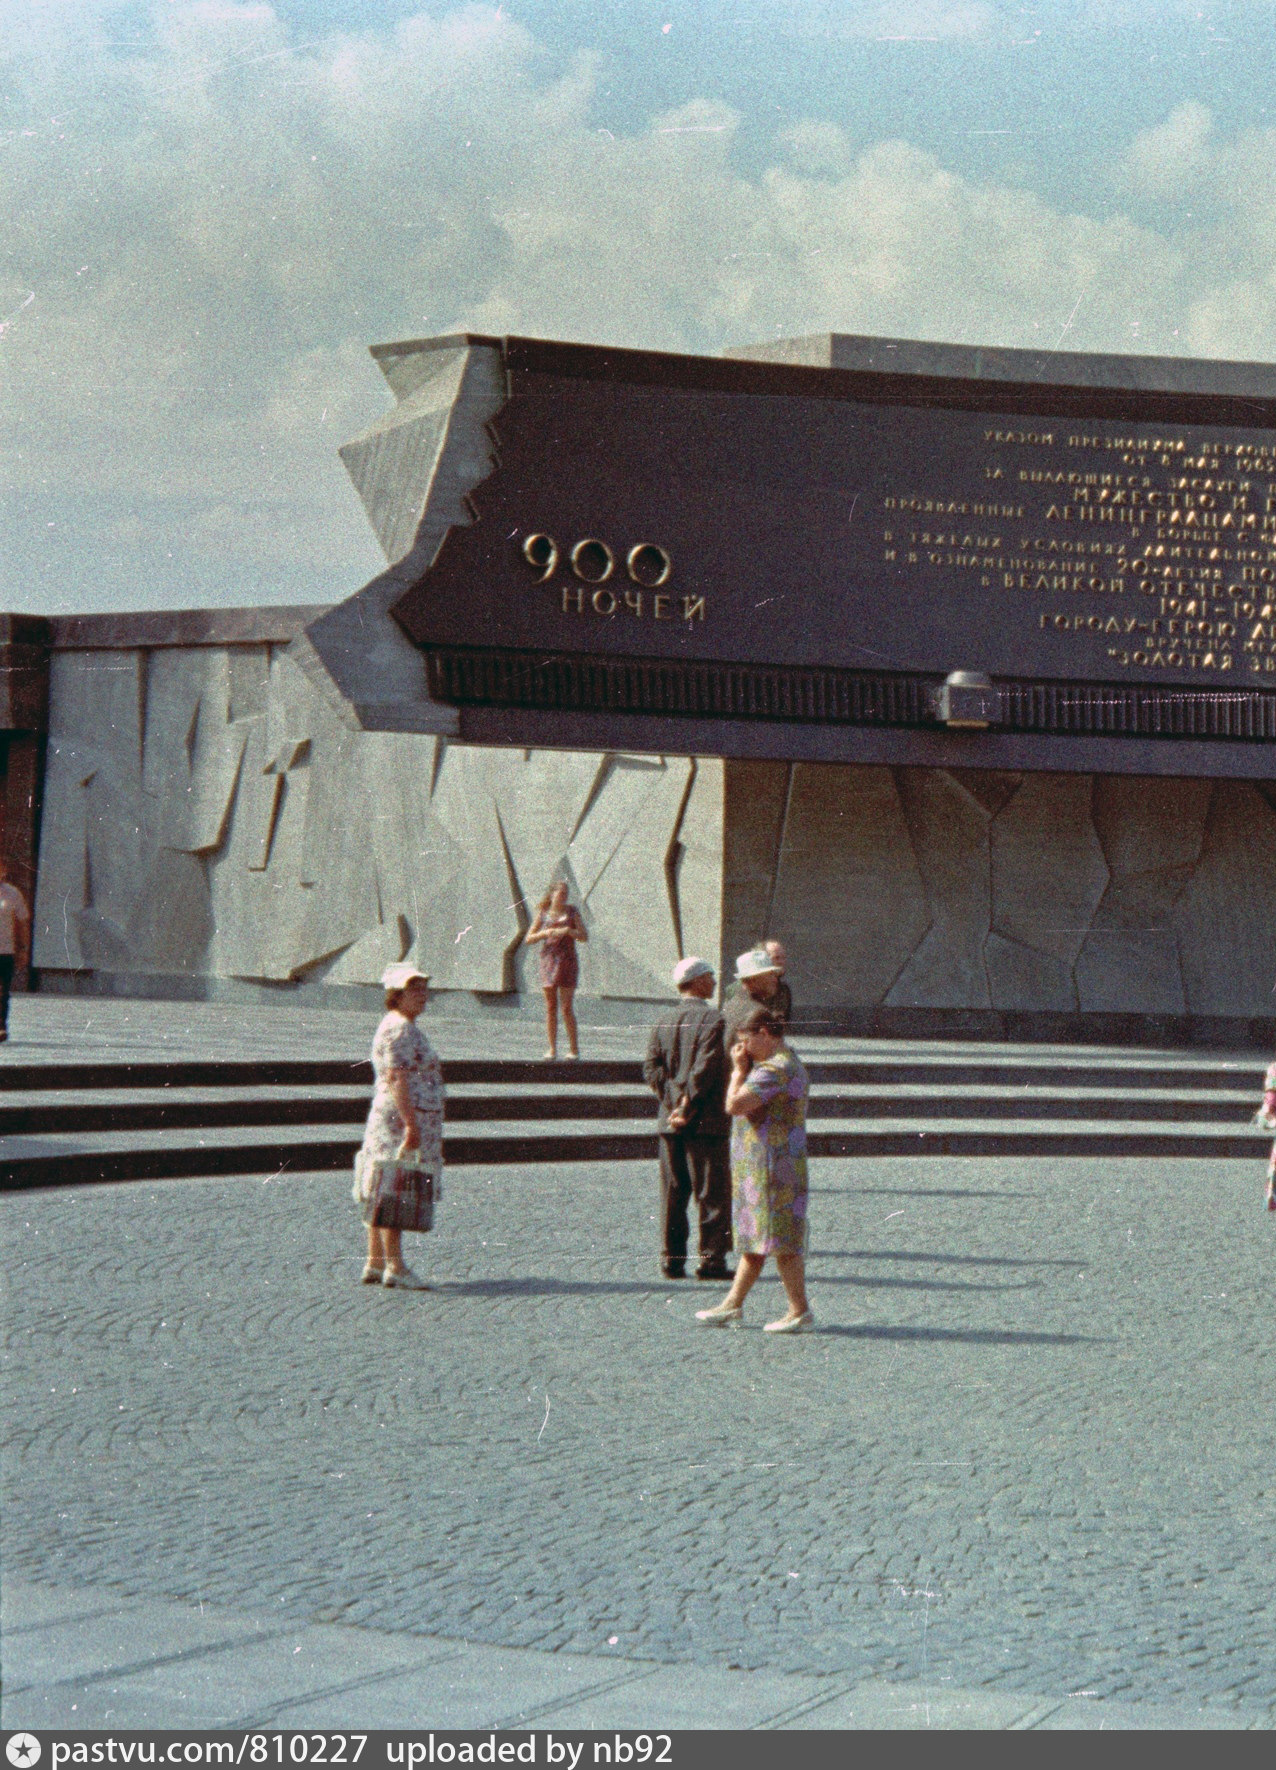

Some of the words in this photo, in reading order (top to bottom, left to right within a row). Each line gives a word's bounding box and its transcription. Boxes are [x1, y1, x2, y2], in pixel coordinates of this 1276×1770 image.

[984, 430, 1054, 445] УКАЗОМ
[1068, 435, 1186, 451] ПРЕЗИДИУМА
[1123, 453, 1146, 466] ОТ
[1183, 456, 1219, 469] МАЯ
[1236, 458, 1275, 473] 1965
[984, 467, 1003, 479] ЗА
[1019, 470, 1150, 488] ВЫДАЮЩИЕСЯ
[1170, 476, 1250, 492] ЗАСЛУГИ
[884, 497, 1024, 517] ПРОЯВЛЕННЫЕ
[1074, 487, 1215, 508] МУЖЕСТВО
[1233, 495, 1248, 510] И
[884, 530, 892, 541] В
[910, 532, 1001, 548] ТЯЖЕЛЫХ
[1020, 538, 1126, 554] УСЛОВИЯХ
[1132, 527, 1139, 539] В
[1157, 528, 1222, 541] БОРЬБЕ
[1237, 531, 1248, 543] С
[523, 532, 672, 588] 900
[885, 550, 896, 561] И
[908, 552, 918, 563] В
[929, 553, 1097, 572] ОЗНАМЕНОВАНИЕ
[1117, 557, 1222, 579] 20-ЛЕТИЯ
[981, 575, 990, 587] В
[1004, 572, 1124, 593] ВЕЛИКОЙ
[561, 586, 706, 622] НОЧЕЙ
[1039, 614, 1236, 637] ГОРОДУ-ГЕРОЮ
[1146, 636, 1231, 650] ВРУЧЕНА
[1108, 648, 1232, 670] "ЗОЛОТАЯ
